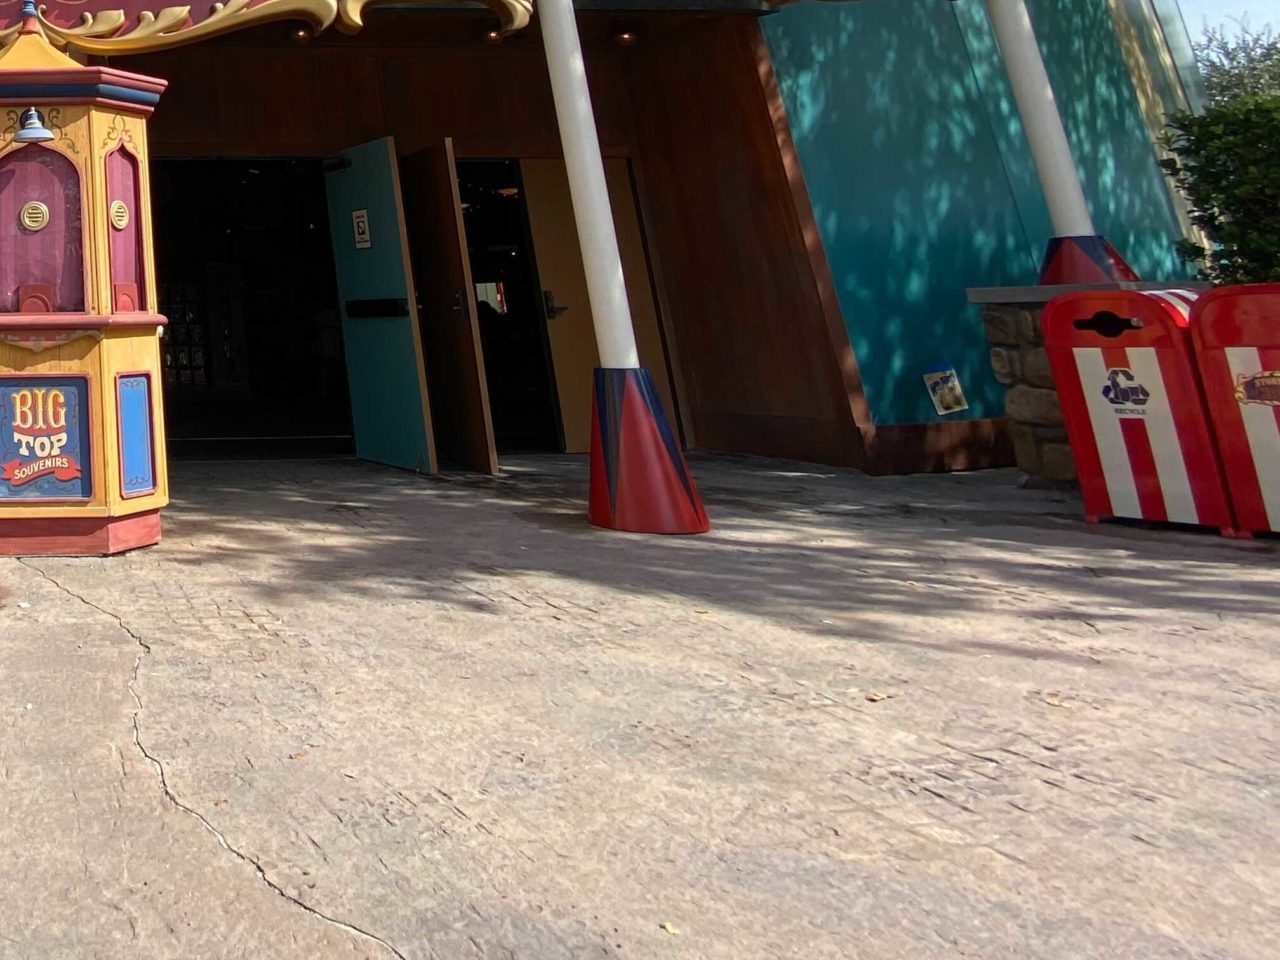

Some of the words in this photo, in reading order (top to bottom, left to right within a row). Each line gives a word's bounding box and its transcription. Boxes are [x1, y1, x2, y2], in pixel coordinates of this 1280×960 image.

[12, 388, 66, 430] BIG
[13, 432, 68, 458] TOP
[14, 457, 69, 480] SOUVENIRS
